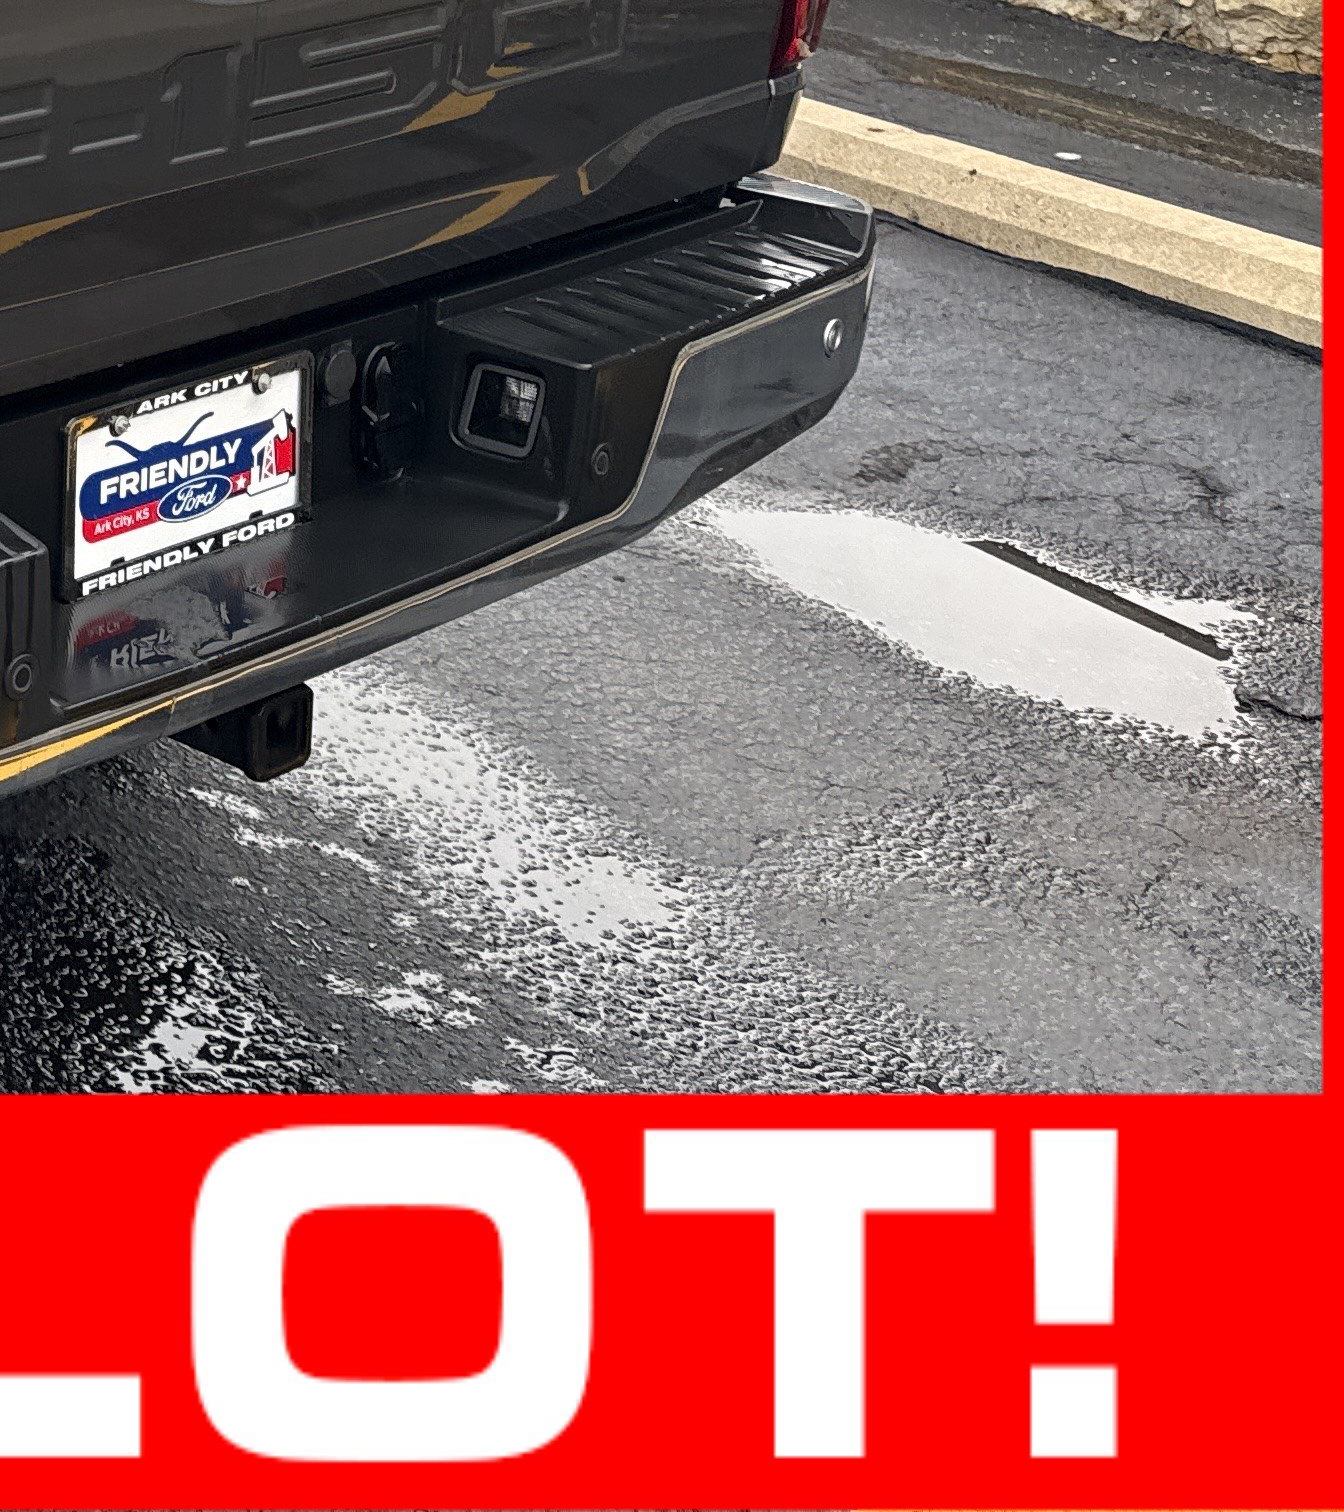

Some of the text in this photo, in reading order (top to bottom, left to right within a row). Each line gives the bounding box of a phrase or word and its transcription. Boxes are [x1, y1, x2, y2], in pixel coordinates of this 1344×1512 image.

[136, 370, 249, 415] ARK CITY
[99, 438, 243, 505] FRIENDLY
[93, 520, 113, 536] Ark
[135, 507, 150, 523] KS
[171, 482, 217, 517] Ford
[82, 512, 296, 597] FRIENDLY FORD
